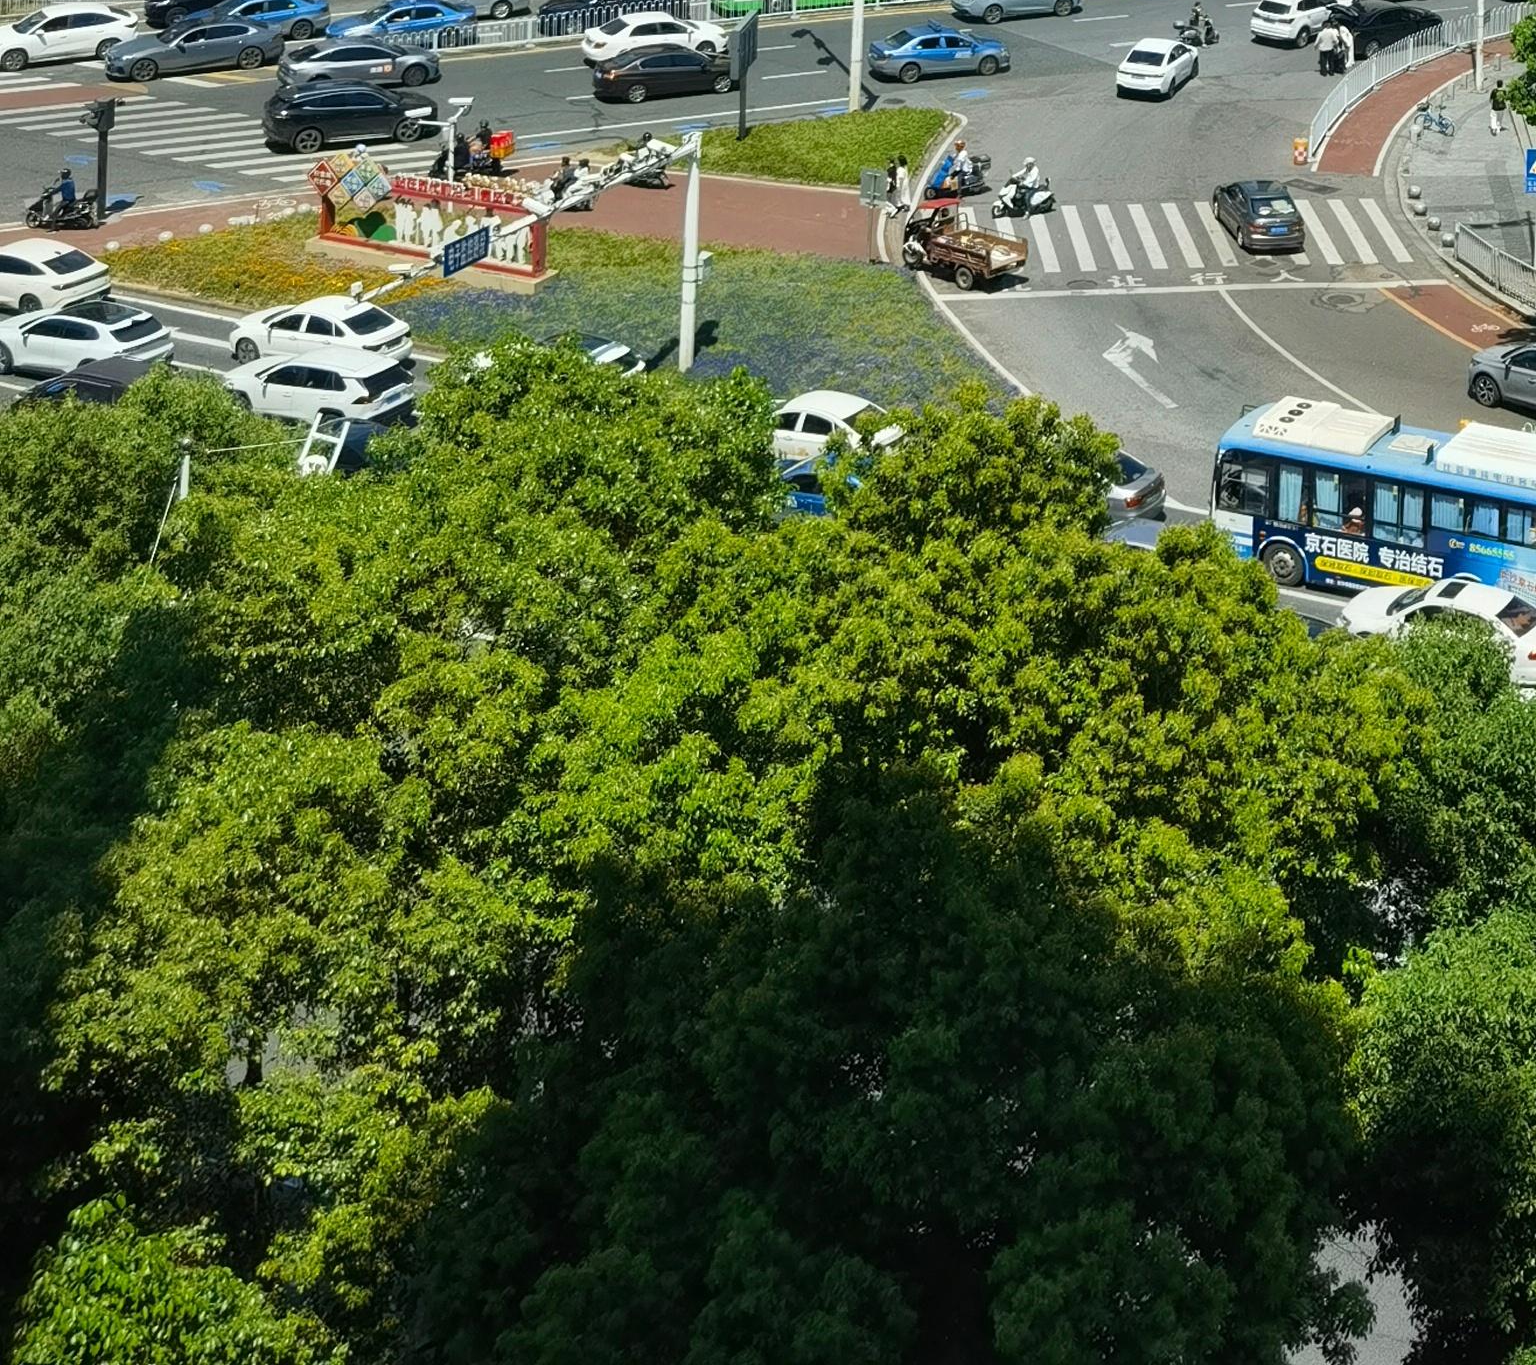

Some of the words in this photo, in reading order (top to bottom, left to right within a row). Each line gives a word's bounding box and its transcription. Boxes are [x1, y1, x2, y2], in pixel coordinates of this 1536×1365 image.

[1304, 532, 1370, 564] 京石医院
[1378, 546, 1444, 578] 专治结石
